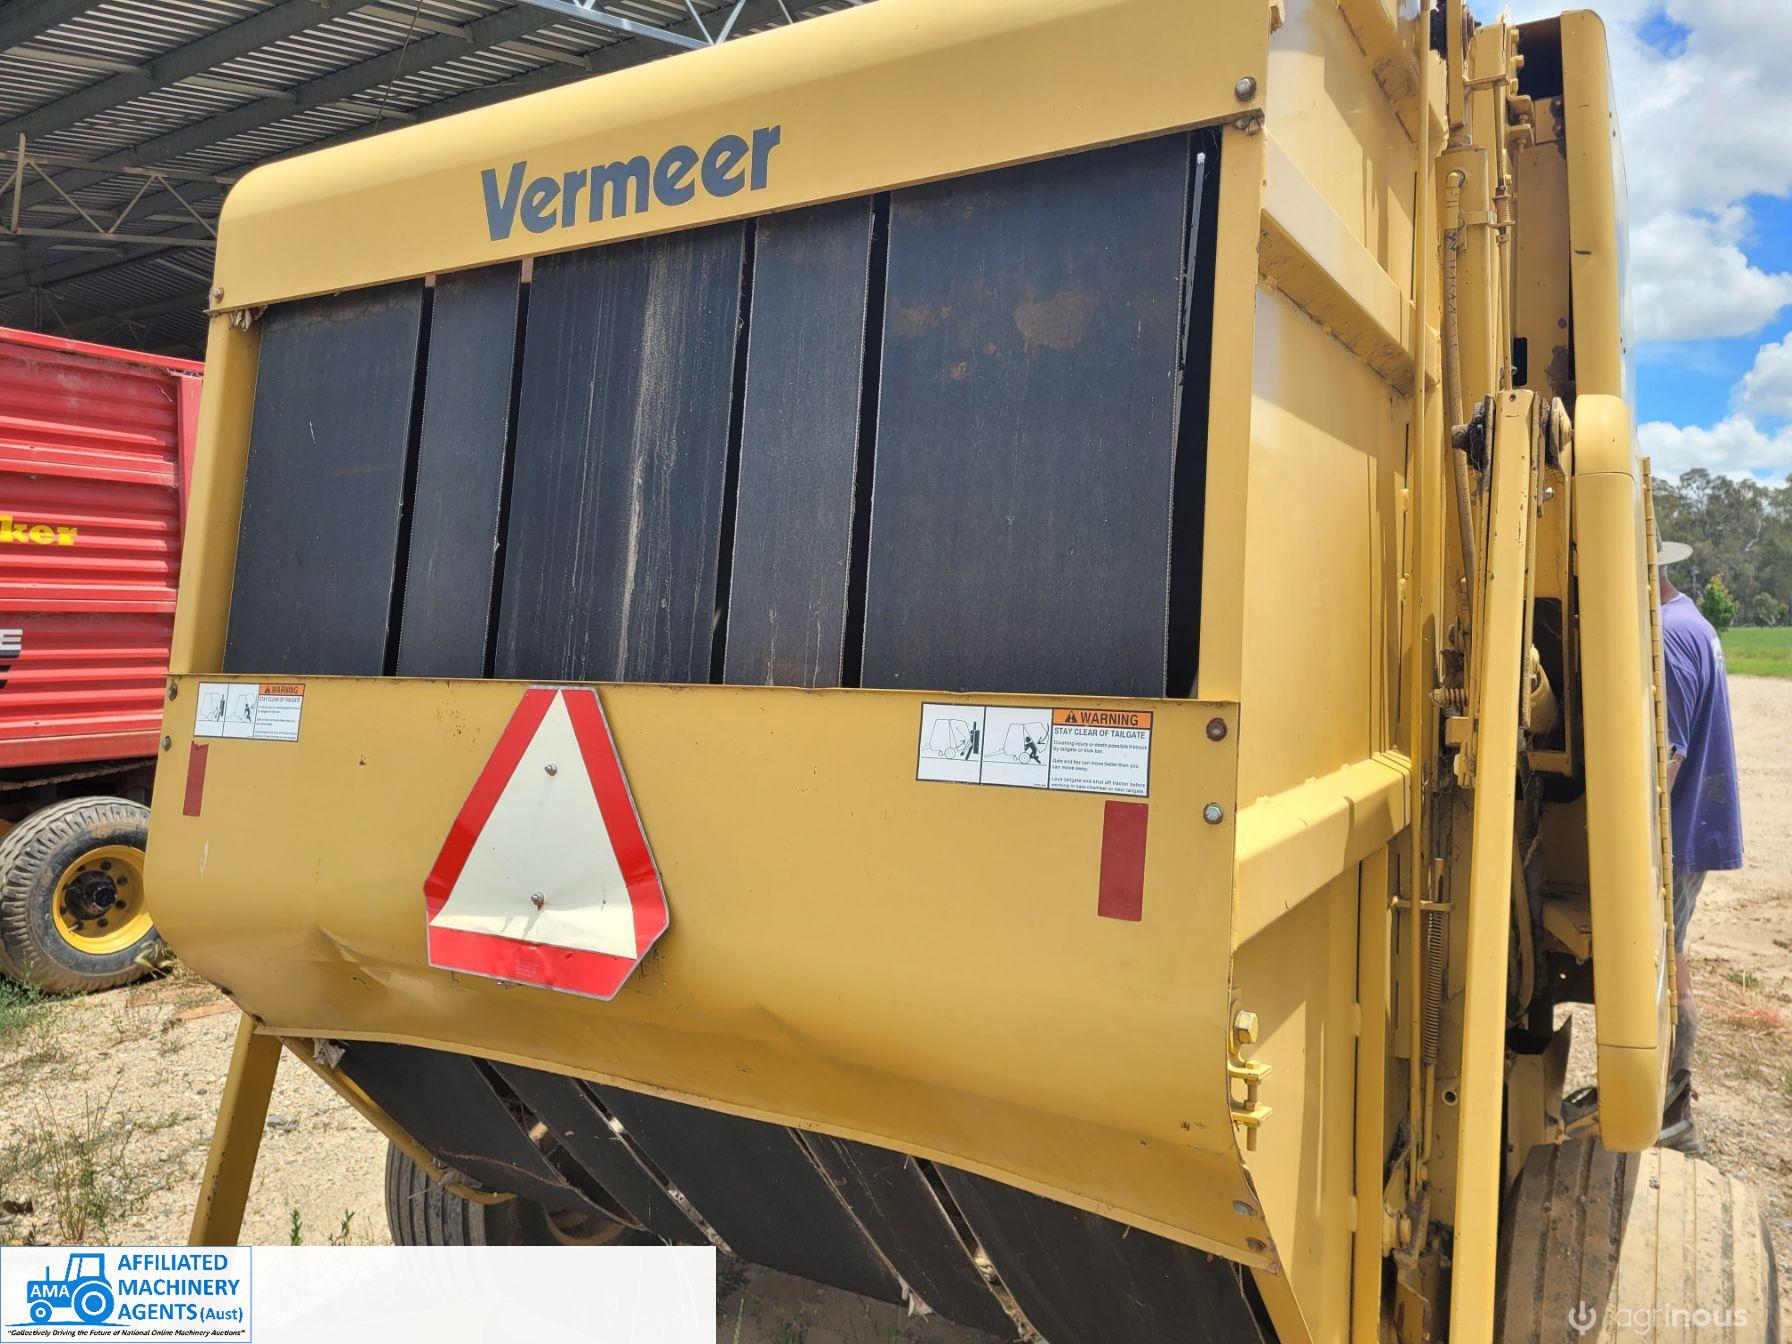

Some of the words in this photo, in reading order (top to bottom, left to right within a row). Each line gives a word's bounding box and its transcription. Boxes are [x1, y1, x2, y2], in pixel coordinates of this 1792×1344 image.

[480, 124, 781, 242] Vermeer
[272, 685, 298, 694] WARNING
[1081, 712, 1138, 726] WARNING
[1111, 731, 1145, 739] TAILGATE
